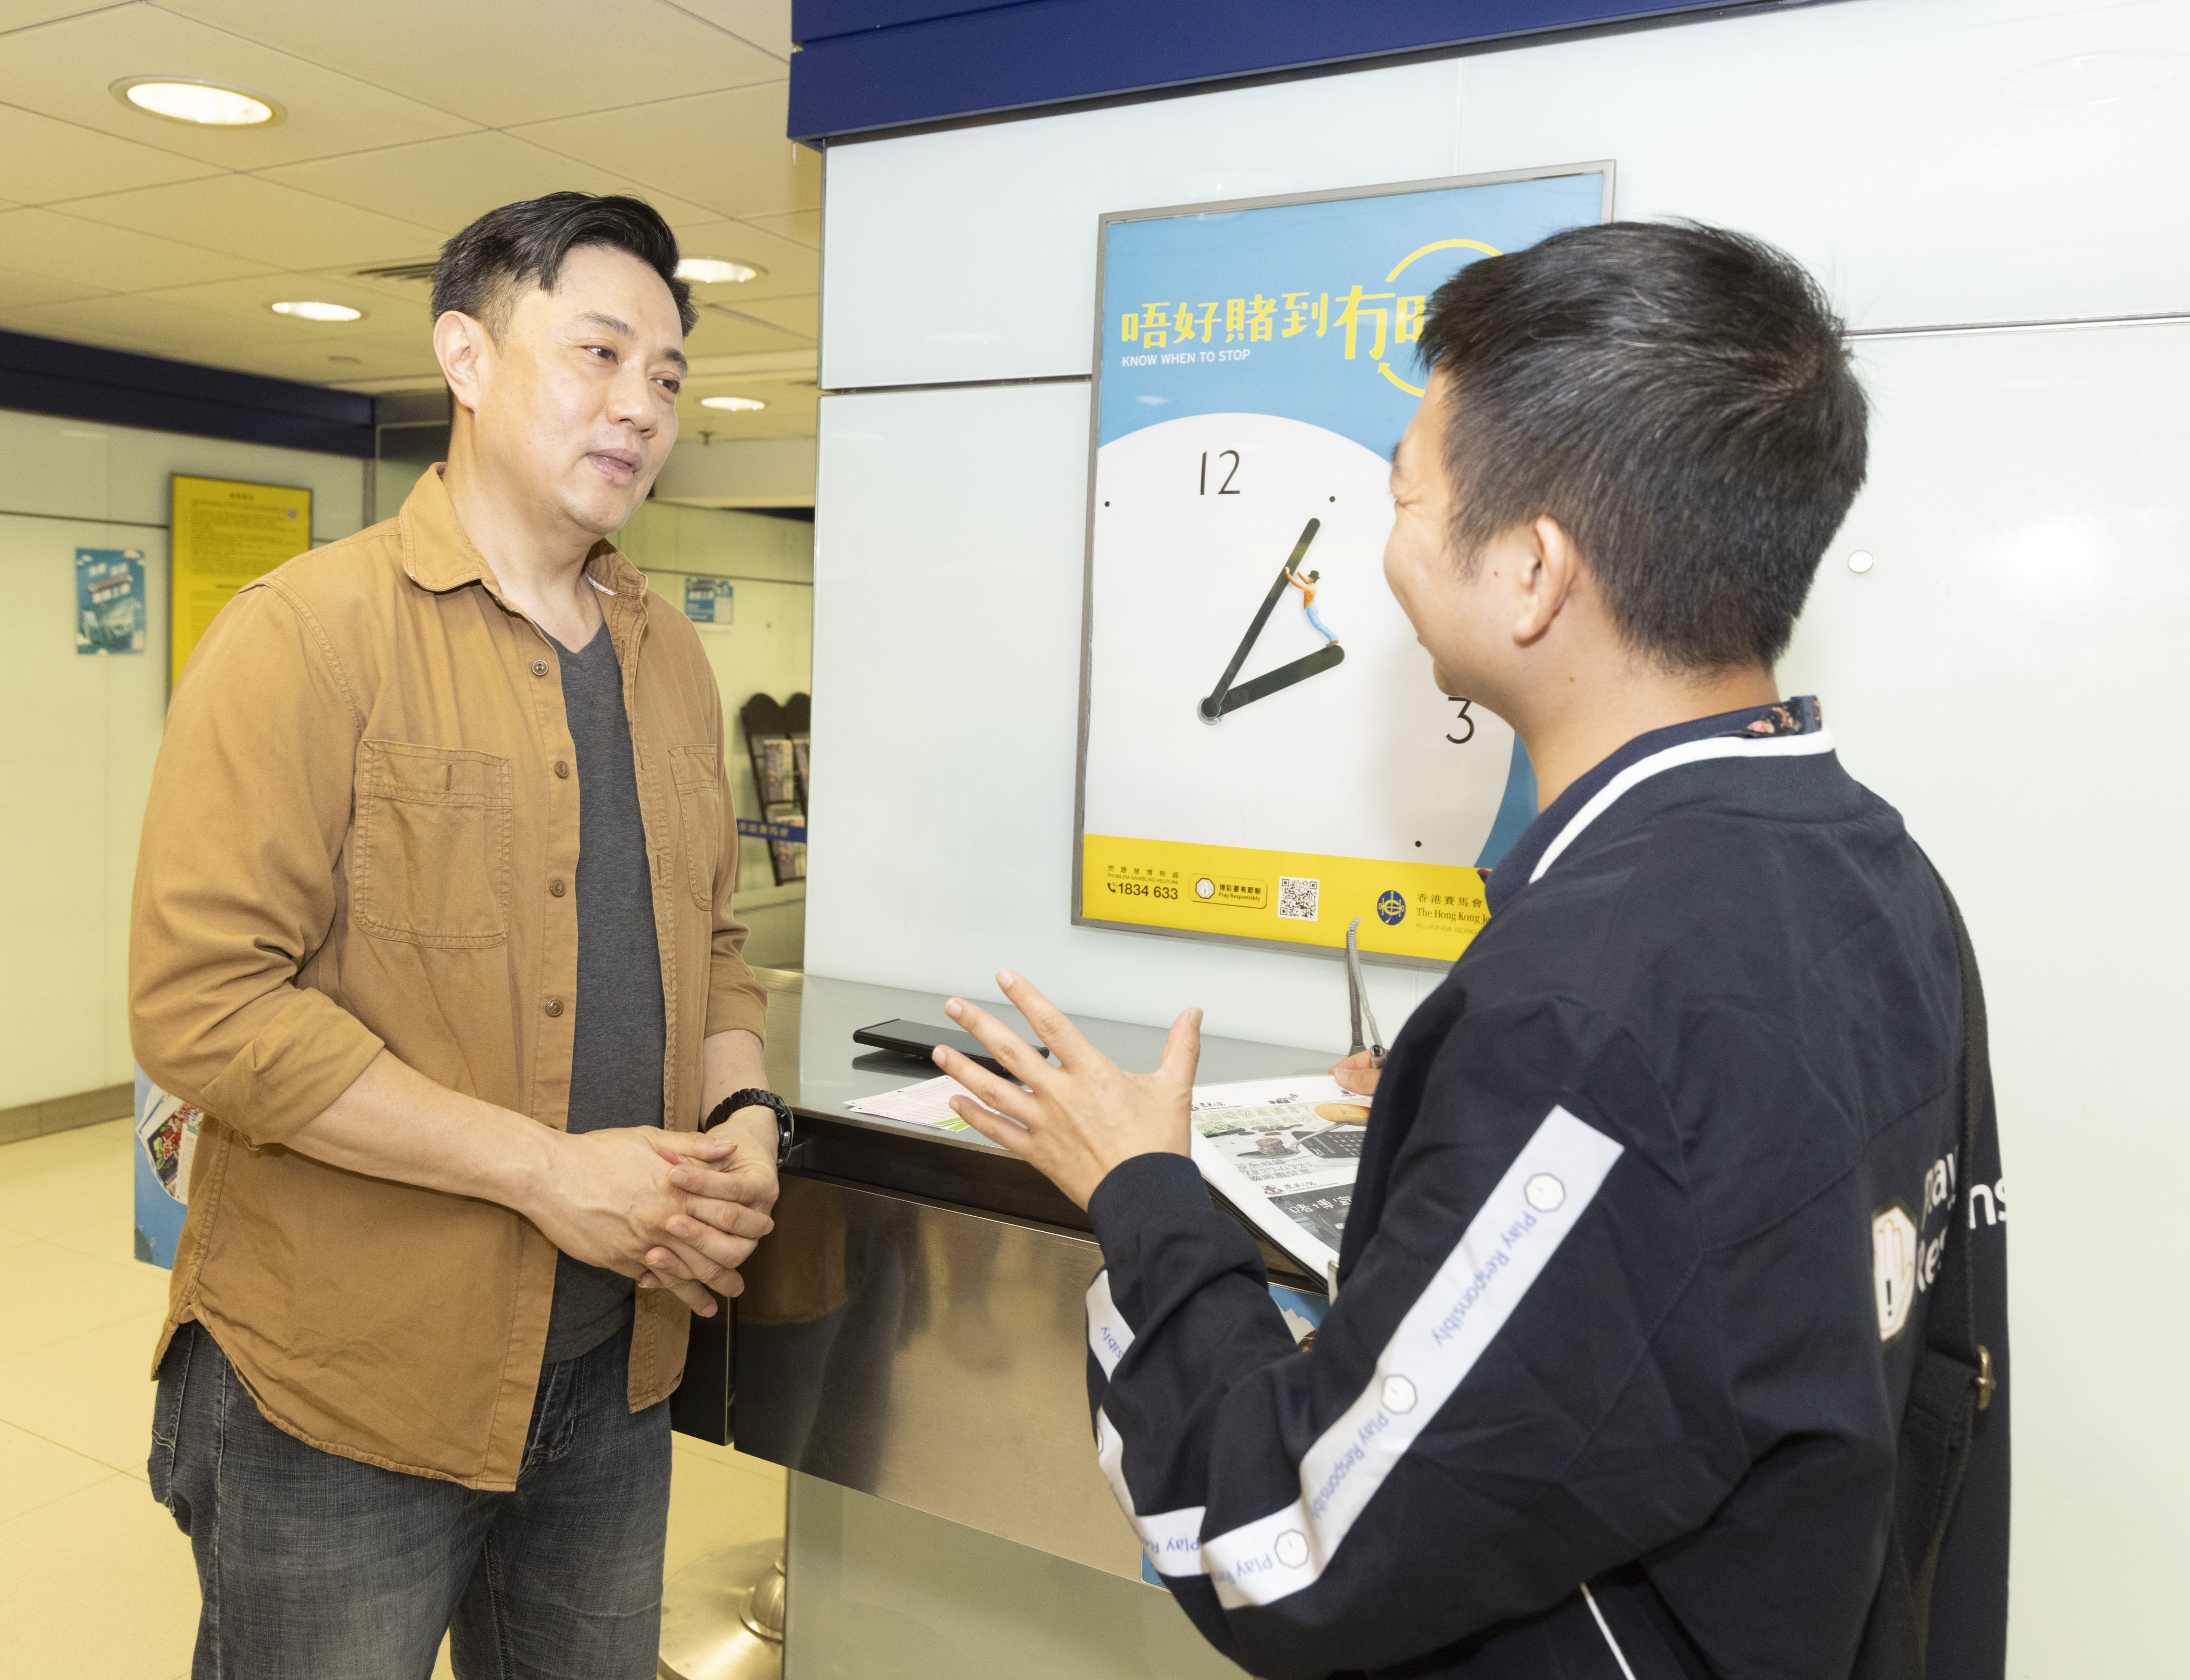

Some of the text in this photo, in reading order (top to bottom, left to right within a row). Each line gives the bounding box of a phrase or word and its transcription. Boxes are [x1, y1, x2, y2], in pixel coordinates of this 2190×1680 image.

[1122, 349, 1251, 367] KNOW WHEN TO STOP
[1200, 449, 1241, 495] 12
[1446, 696, 1475, 744] 3
[1118, 883, 1178, 900] 1834 633
[1219, 884, 1261, 895] 博彩要有節制
[1230, 893, 1261, 902] Responsibly
[1418, 893, 1482, 908] 香港賽馬會
[1417, 908, 1432, 917] The
[1435, 910, 1456, 922] Hong
[1458, 911, 1480, 925] Kong
[1431, 1210, 1538, 1347] Play Responsibly
[1357, 1410, 1389, 1445] Play
[1167, 1536, 1200, 1552] Play
[1236, 1553, 1274, 1577] Play
